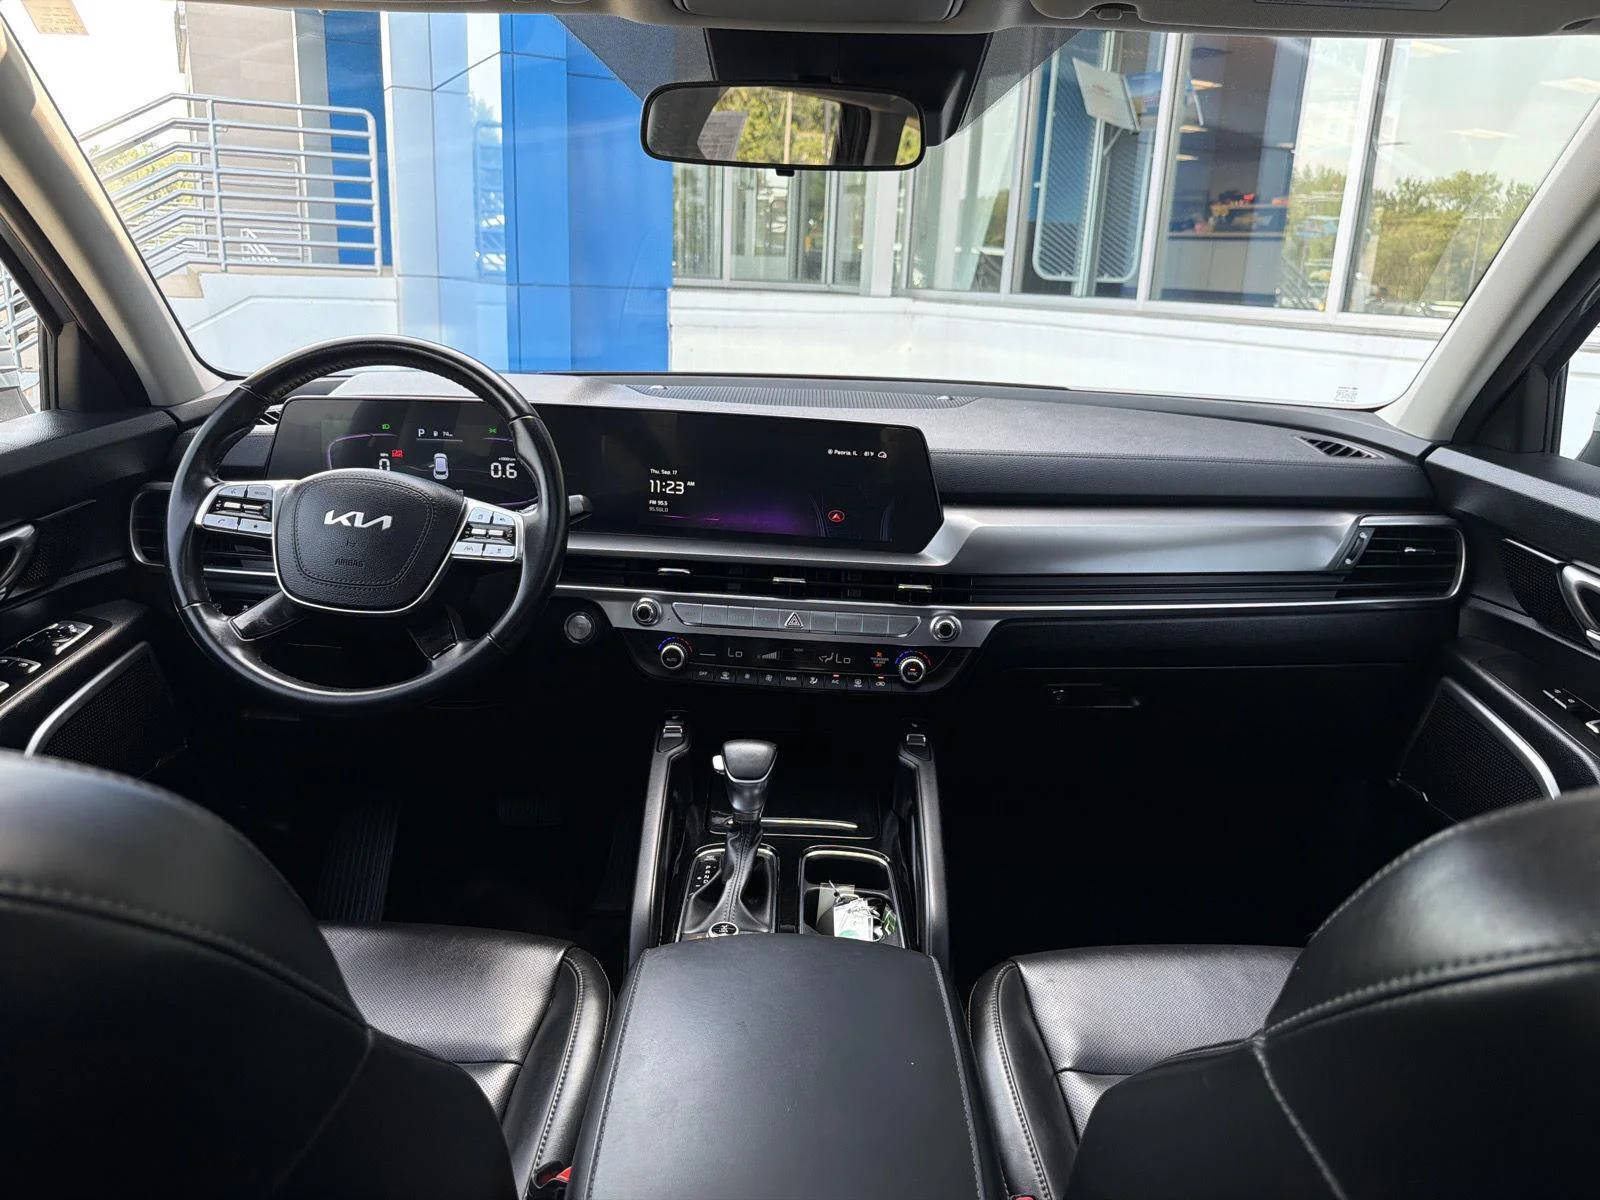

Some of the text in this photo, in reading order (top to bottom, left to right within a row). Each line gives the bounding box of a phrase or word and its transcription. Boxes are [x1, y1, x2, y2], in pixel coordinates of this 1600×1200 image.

[418, 429, 425, 437] P
[490, 462, 518, 479] 0.6
[649, 479, 684, 494] 11:23
[323, 509, 393, 531] KIA
[334, 558, 364, 568] AIRBAG
[727, 647, 743, 658] Lo
[835, 653, 851, 664] Lo
